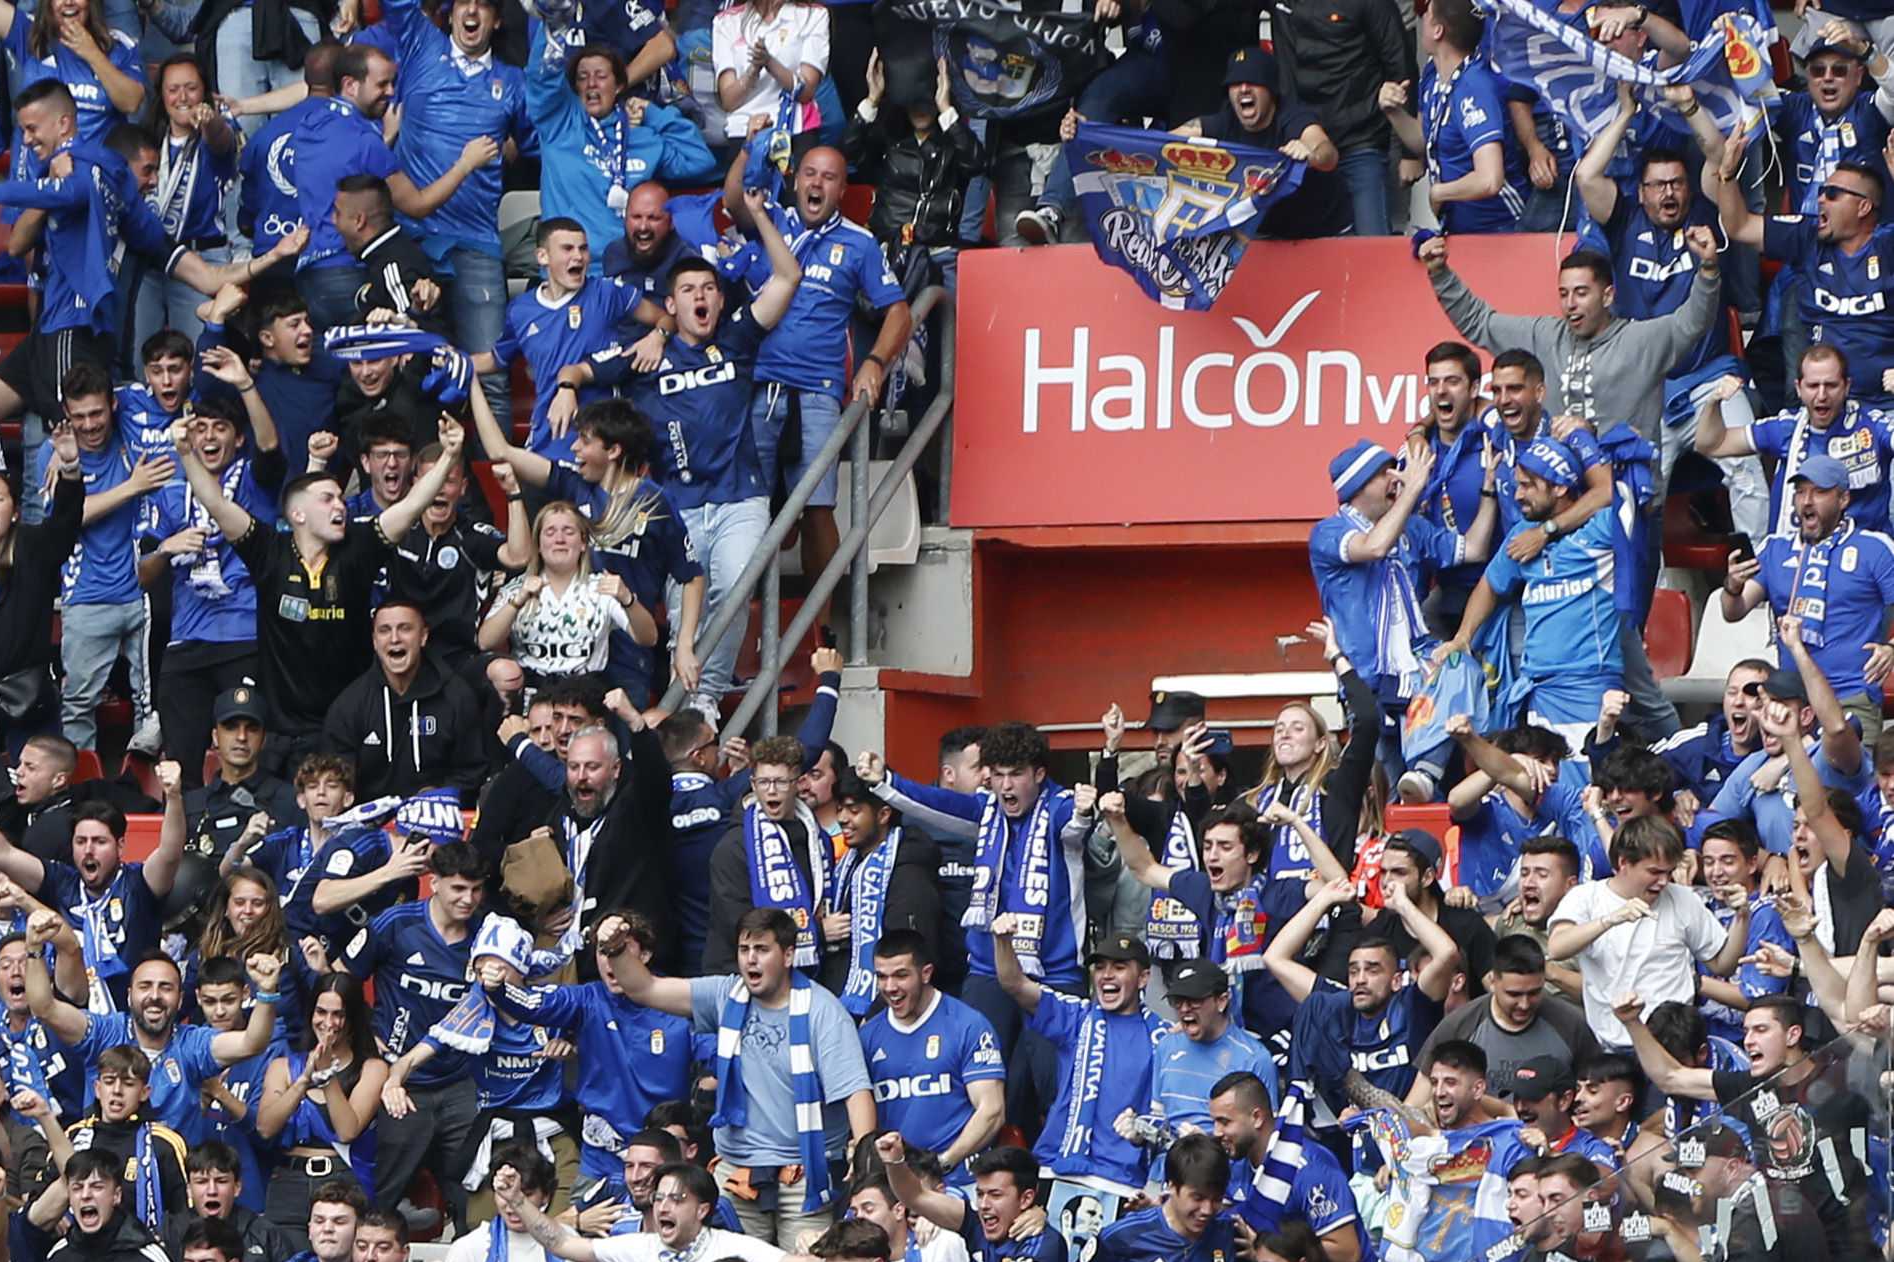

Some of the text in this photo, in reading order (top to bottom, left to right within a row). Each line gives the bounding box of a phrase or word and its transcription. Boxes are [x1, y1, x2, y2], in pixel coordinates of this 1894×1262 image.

[1814, 286, 1887, 316] DIGI
[658, 361, 736, 395] DIGI
[938, 863, 975, 877] elles
[1147, 921, 1198, 936] DESDE 1926
[871, 1072, 952, 1104] DIGI
